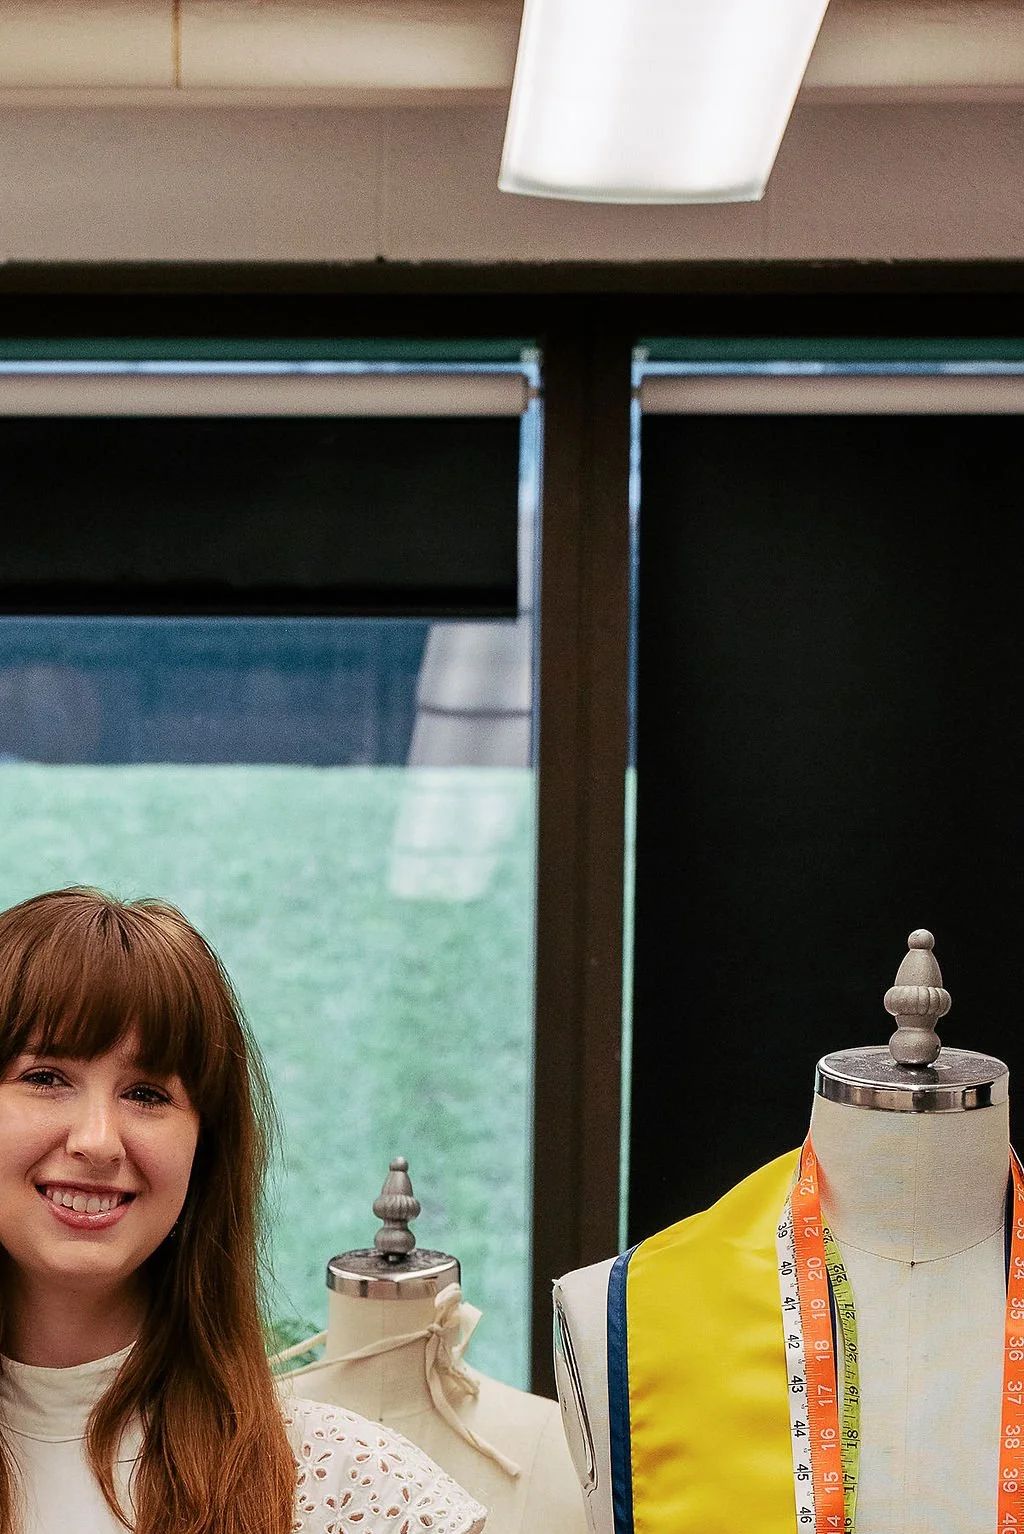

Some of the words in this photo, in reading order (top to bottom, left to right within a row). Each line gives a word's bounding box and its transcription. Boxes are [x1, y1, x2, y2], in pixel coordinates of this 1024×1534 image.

[800, 1176, 814, 1195] 22
[777, 1222, 788, 1239] 39
[804, 1216, 818, 1238] 21
[780, 1260, 793, 1276] 40
[806, 1257, 823, 1280] 20
[834, 1264, 848, 1282] 22
[1014, 1256, 1024, 1280] 34
[783, 1296, 797, 1311] 41
[811, 1298, 826, 1319] 19
[844, 1302, 856, 1320] 21
[1010, 1298, 1024, 1320] 35
[787, 1334, 800, 1349] 42
[814, 1340, 830, 1362] 18
[1008, 1336, 1024, 1360] 36
[847, 1342, 856, 1363] 20
[791, 1375, 804, 1393] 43
[1007, 1380, 1022, 1404] 37
[818, 1384, 832, 1406] 17
[849, 1386, 859, 1404] 19
[794, 1420, 806, 1438] 44
[820, 1428, 836, 1450] 16
[846, 1430, 858, 1448] 18
[1005, 1424, 1020, 1448] 38
[797, 1464, 809, 1481] 45
[1002, 1468, 1018, 1492] 39
[824, 1472, 839, 1494] 15
[844, 1474, 855, 1492] 17
[800, 1506, 812, 1524] 46
